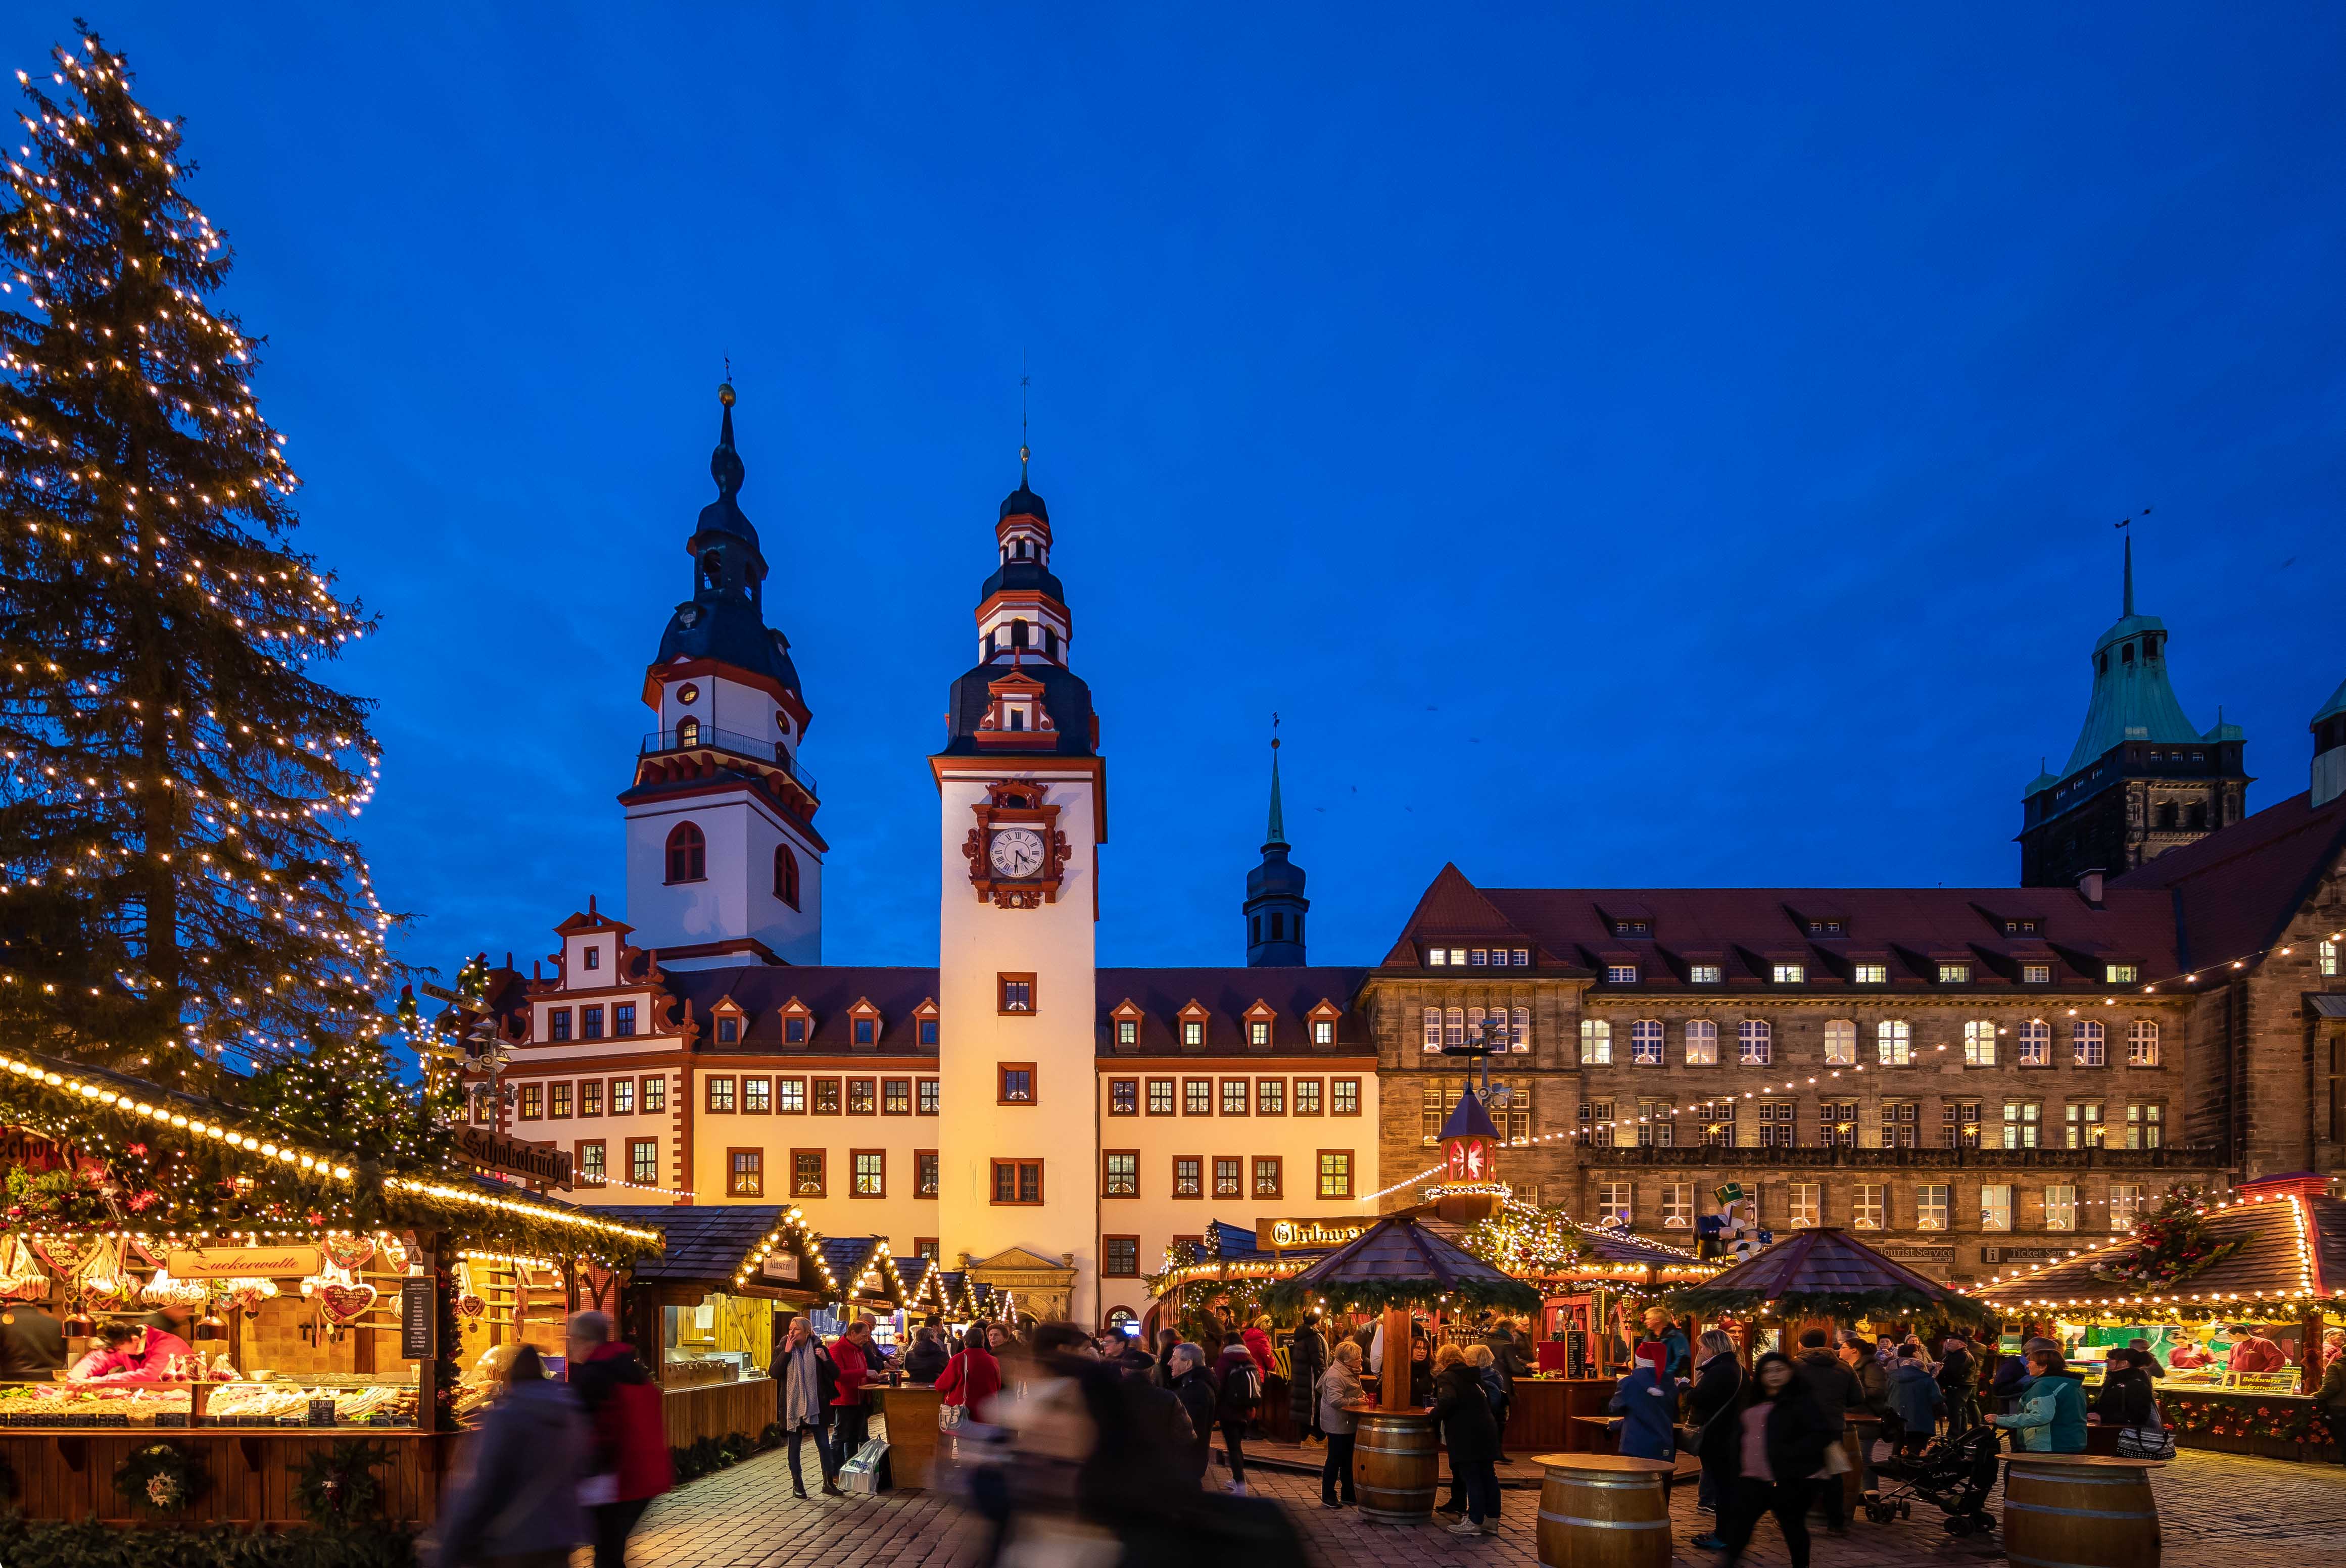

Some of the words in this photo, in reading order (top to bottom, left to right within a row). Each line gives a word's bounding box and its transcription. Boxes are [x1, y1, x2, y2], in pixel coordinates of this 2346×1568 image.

[416, 1043, 454, 1054] MANDELN
[1272, 1223, 1370, 1243] Glühwei
[1879, 1247, 1915, 1256] Tourist
[1917, 1247, 1953, 1256] Service
[2011, 1248, 2041, 1257] Ticket
[188, 1255, 299, 1271] Zuckerwatte
